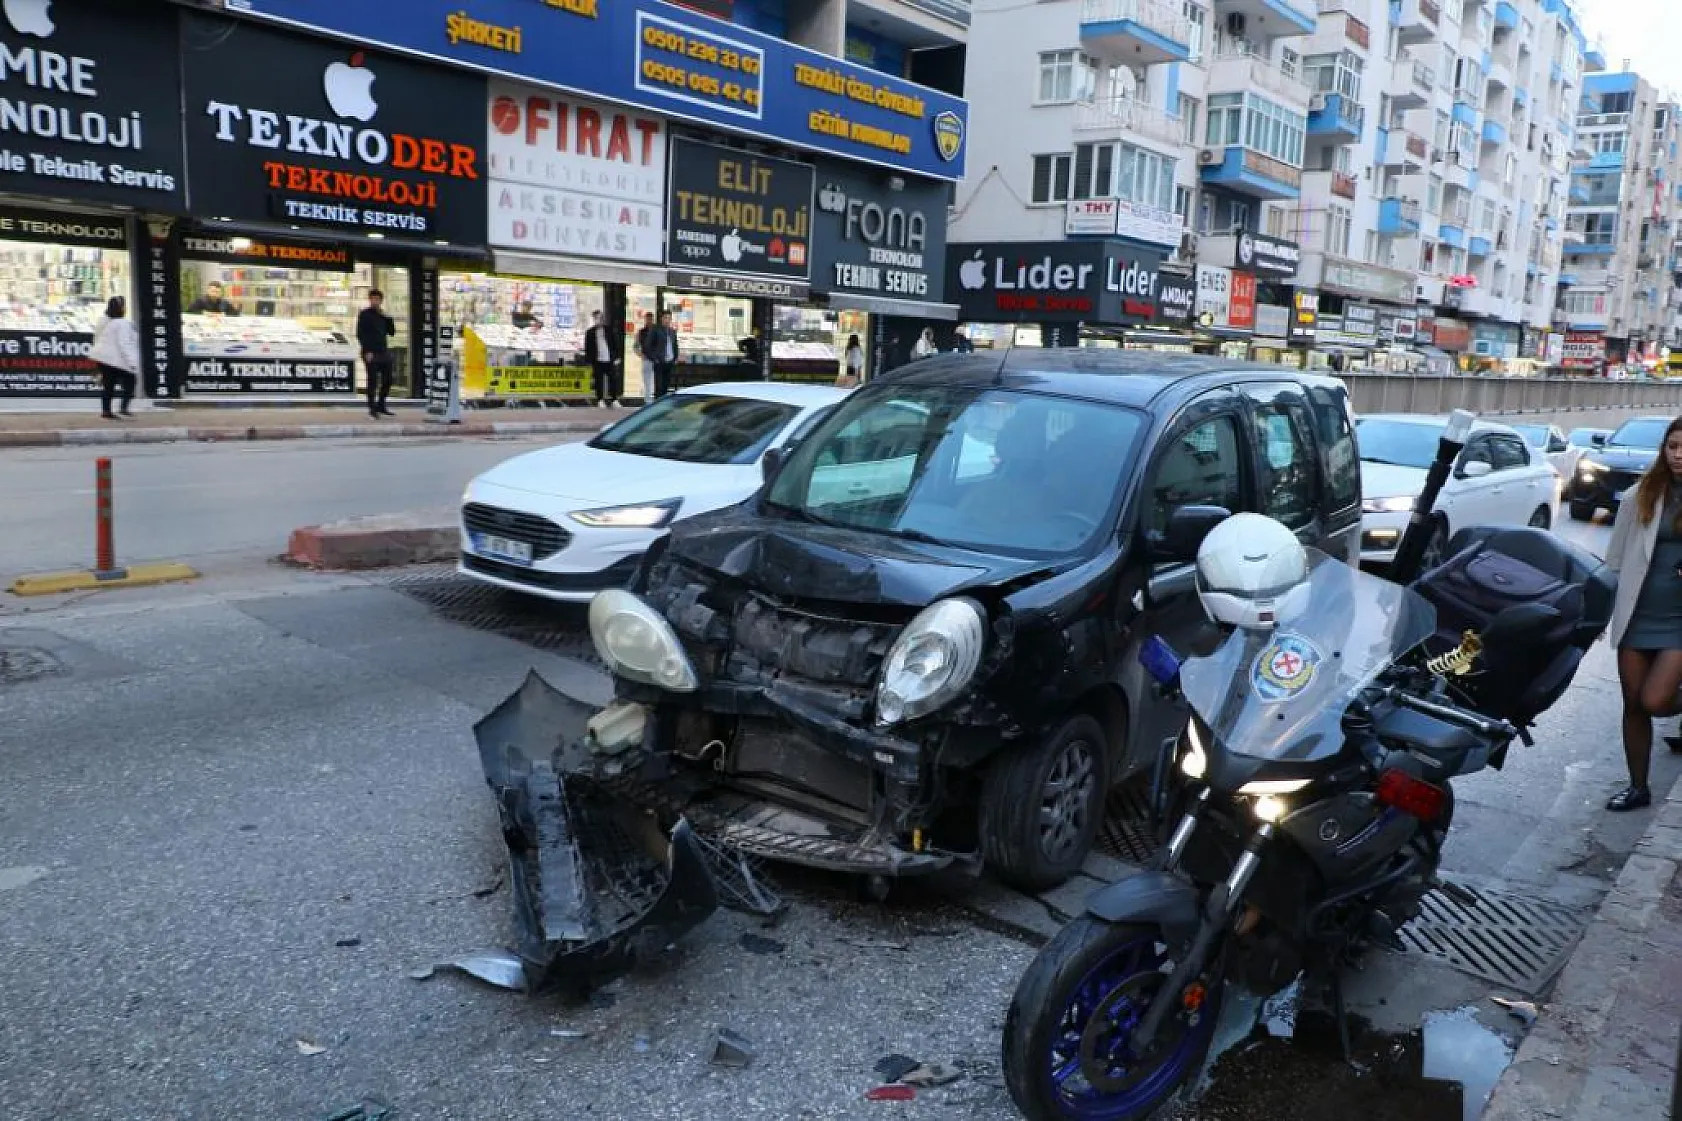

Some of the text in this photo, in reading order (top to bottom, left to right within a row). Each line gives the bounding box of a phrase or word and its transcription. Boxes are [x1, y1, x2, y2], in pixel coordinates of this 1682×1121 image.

[446, 10, 522, 53] ŞİRKETİ
[207, 100, 478, 180] TEKNODER
[525, 94, 660, 167] FIRAT
[29, 153, 106, 182] Teknik
[108, 163, 175, 191] Servis
[263, 161, 438, 208] TEKNOLOJİ
[718, 160, 773, 196] ELİT
[285, 200, 427, 231] TEKNİK SERVİS
[498, 188, 651, 228] AKSESUAR
[676, 190, 808, 238] TEKNOLOJİ
[846, 198, 927, 251] FONA
[1084, 202, 1112, 214] THY
[512, 217, 638, 253] DÜNYASI
[835, 262, 928, 295] TEKNİK SERVİS
[994, 256, 1093, 290] Lider
[1107, 256, 1158, 297] Lider
[188, 358, 349, 379] ACİL TEKNİK SERVİS
